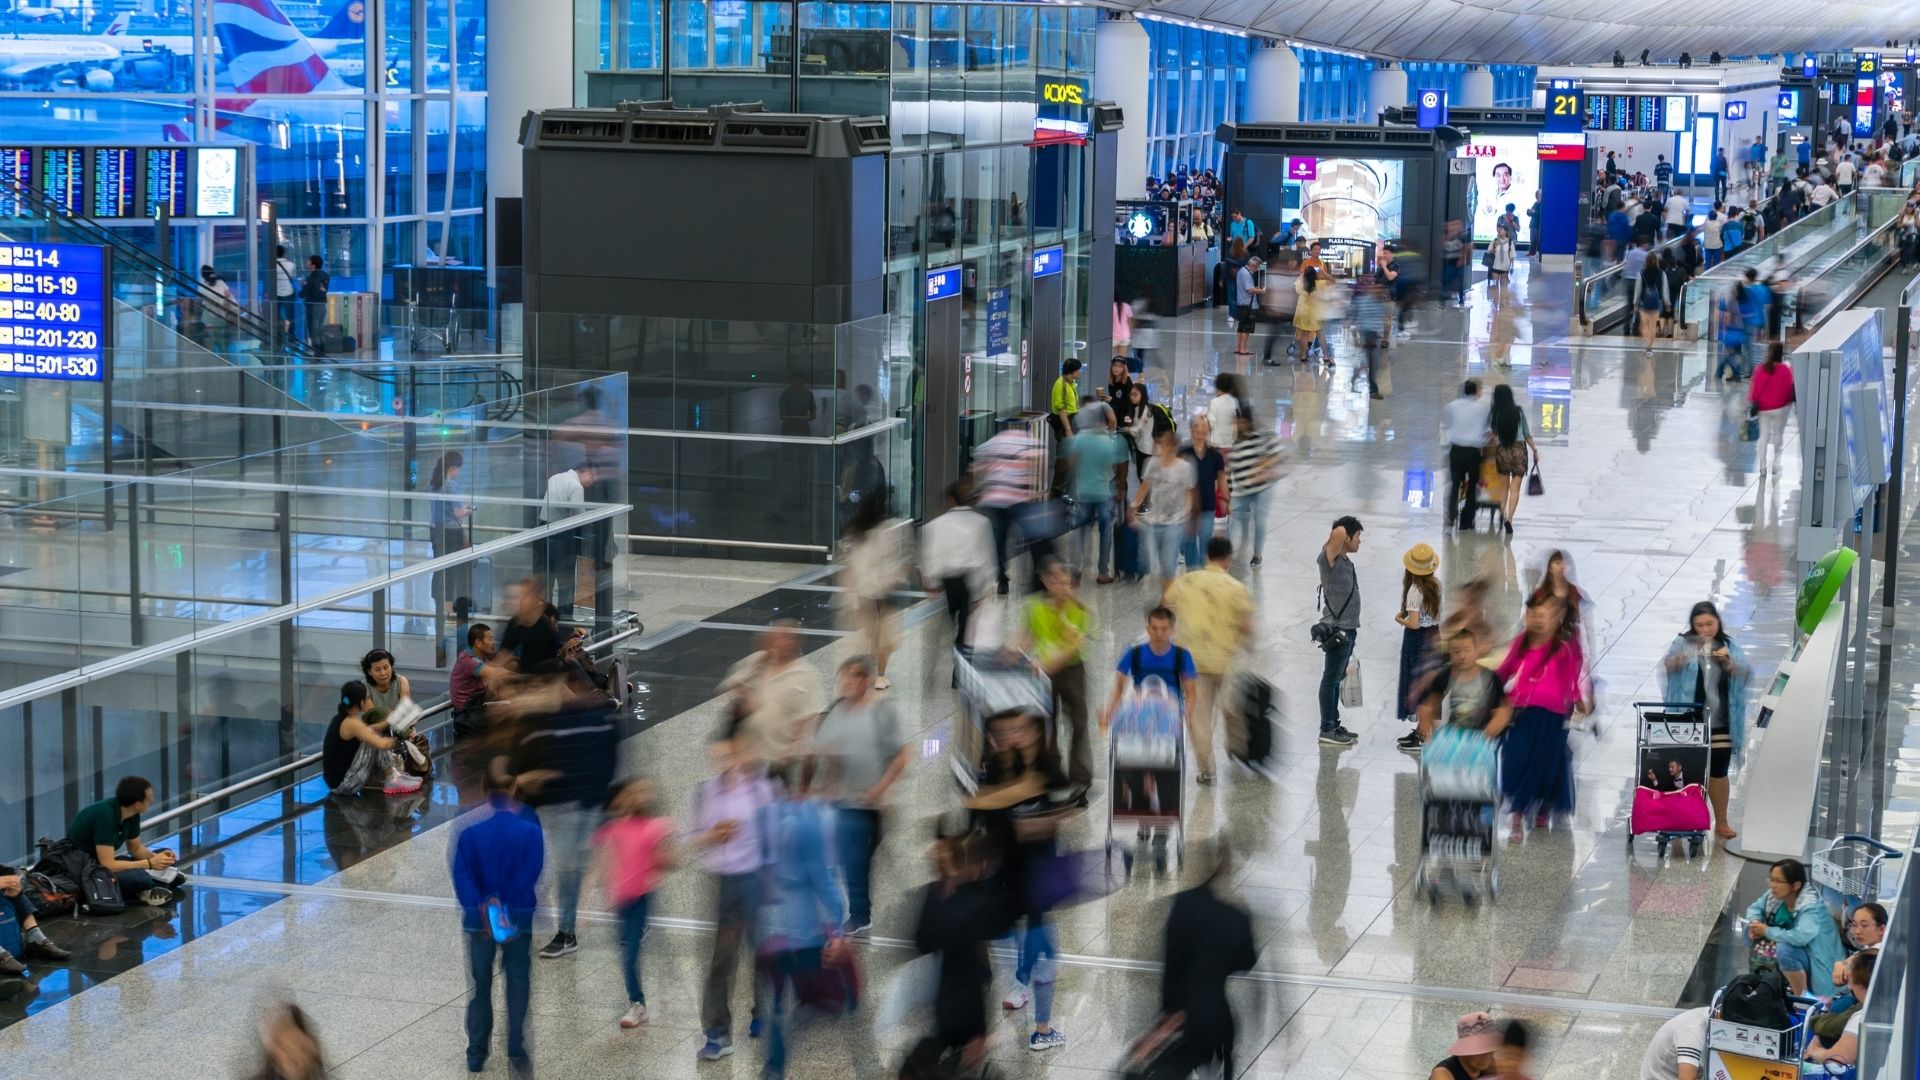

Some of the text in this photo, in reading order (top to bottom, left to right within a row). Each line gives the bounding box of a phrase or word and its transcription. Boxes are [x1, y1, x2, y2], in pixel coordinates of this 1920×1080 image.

[1860, 60, 1874, 72] 23
[1554, 95, 1577, 115] 21
[35, 249, 59, 268] 1-4
[35, 275, 77, 295] 15-19
[36, 302, 80, 322] 40-80
[35, 328, 97, 349] 201-230
[36, 355, 97, 376] 501-530
